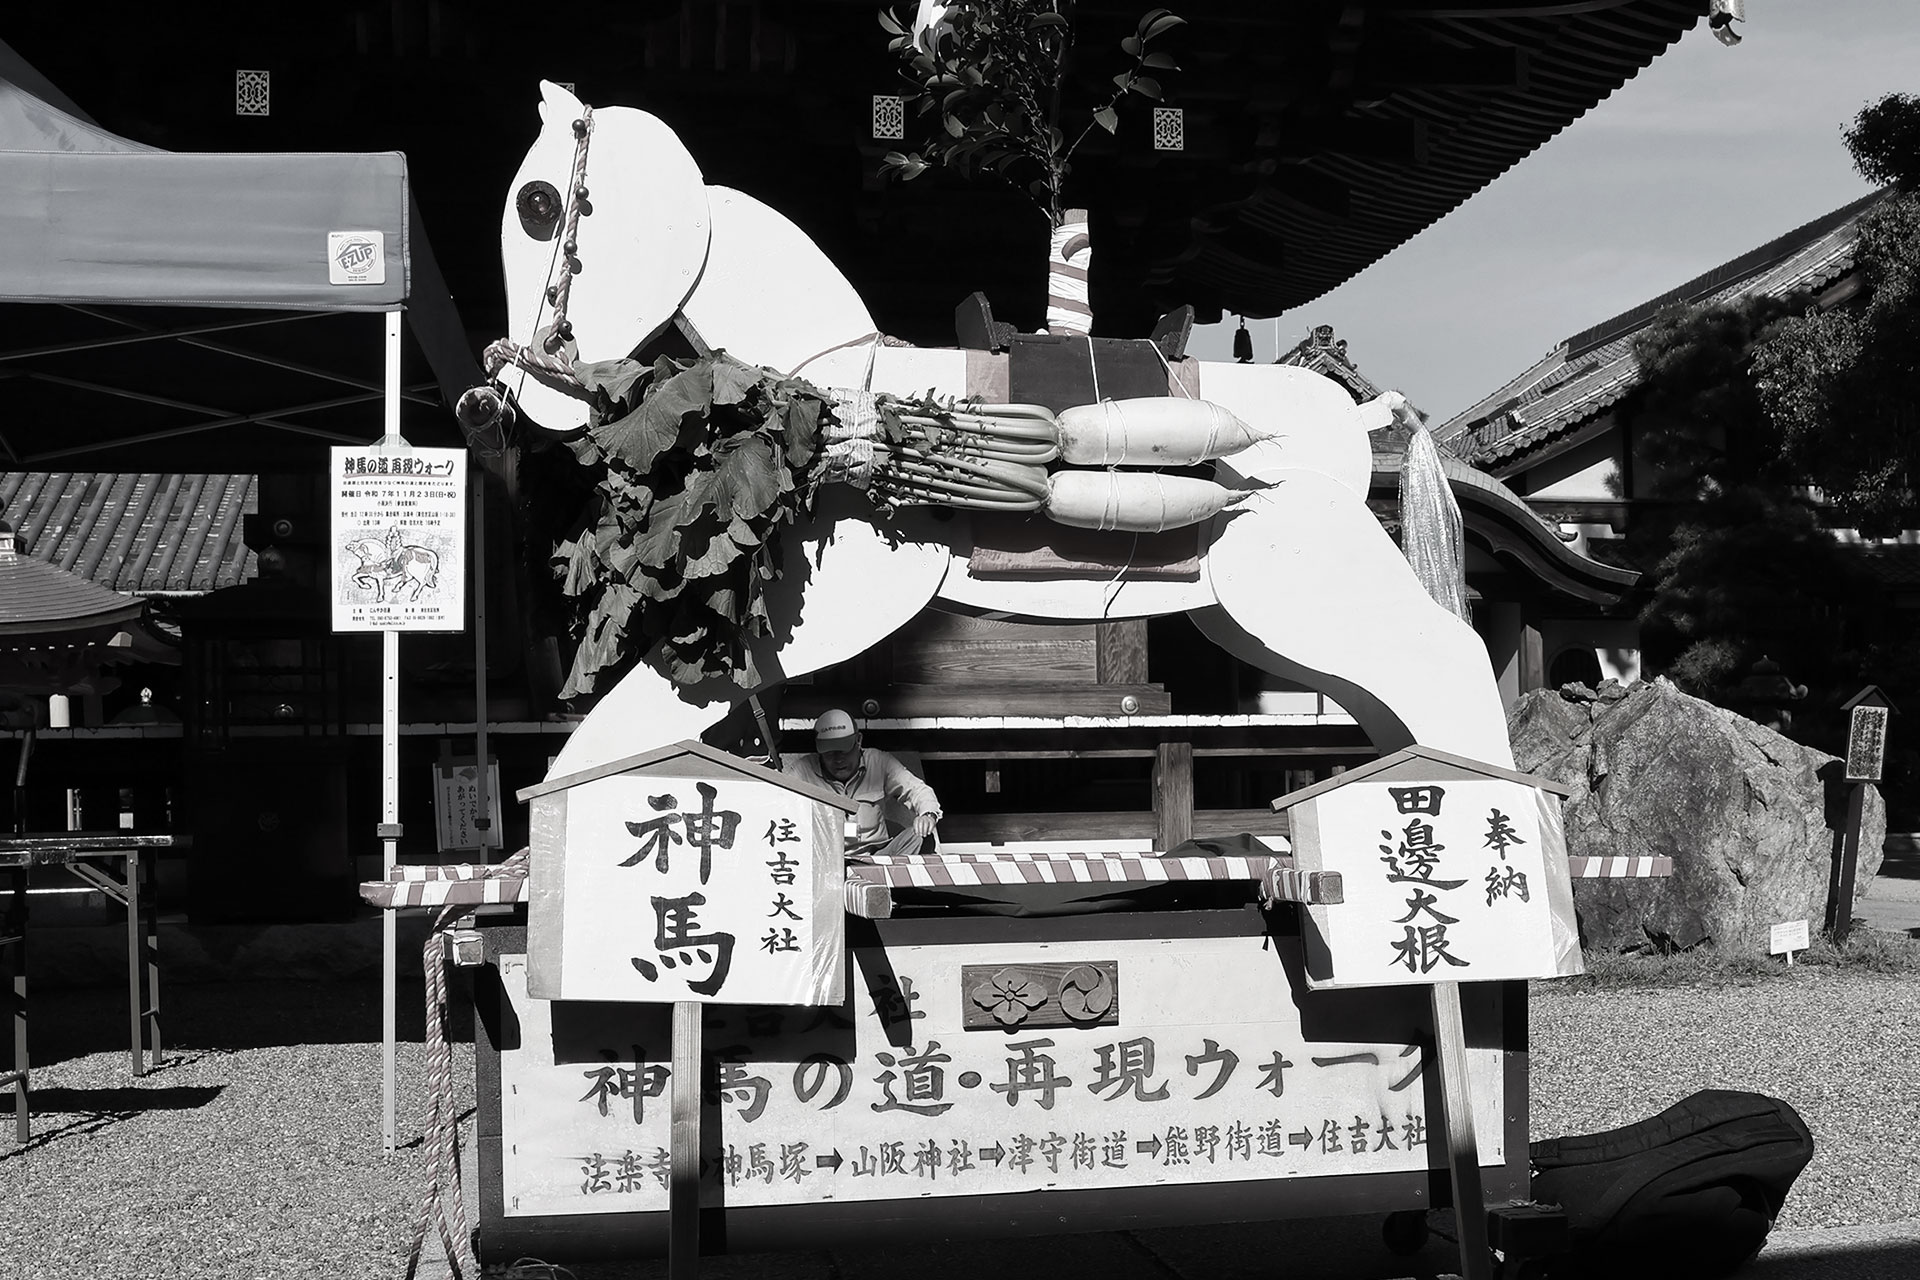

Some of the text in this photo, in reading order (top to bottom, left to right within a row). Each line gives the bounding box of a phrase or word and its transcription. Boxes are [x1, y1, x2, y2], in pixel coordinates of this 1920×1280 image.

[344, 456, 455, 476] 神馬の道 再現ウォーク
[616, 781, 742, 997] 神馬
[759, 817, 804, 955] 住吉大社
[1482, 807, 1531, 908] 奉納
[851, 1138, 977, 1179] 山阪神社
[1007, 1130, 1130, 1174] 津守街道
[1161, 1119, 1286, 1165] 熊野街道
[1317, 1114, 1429, 1156] 住吉大社
